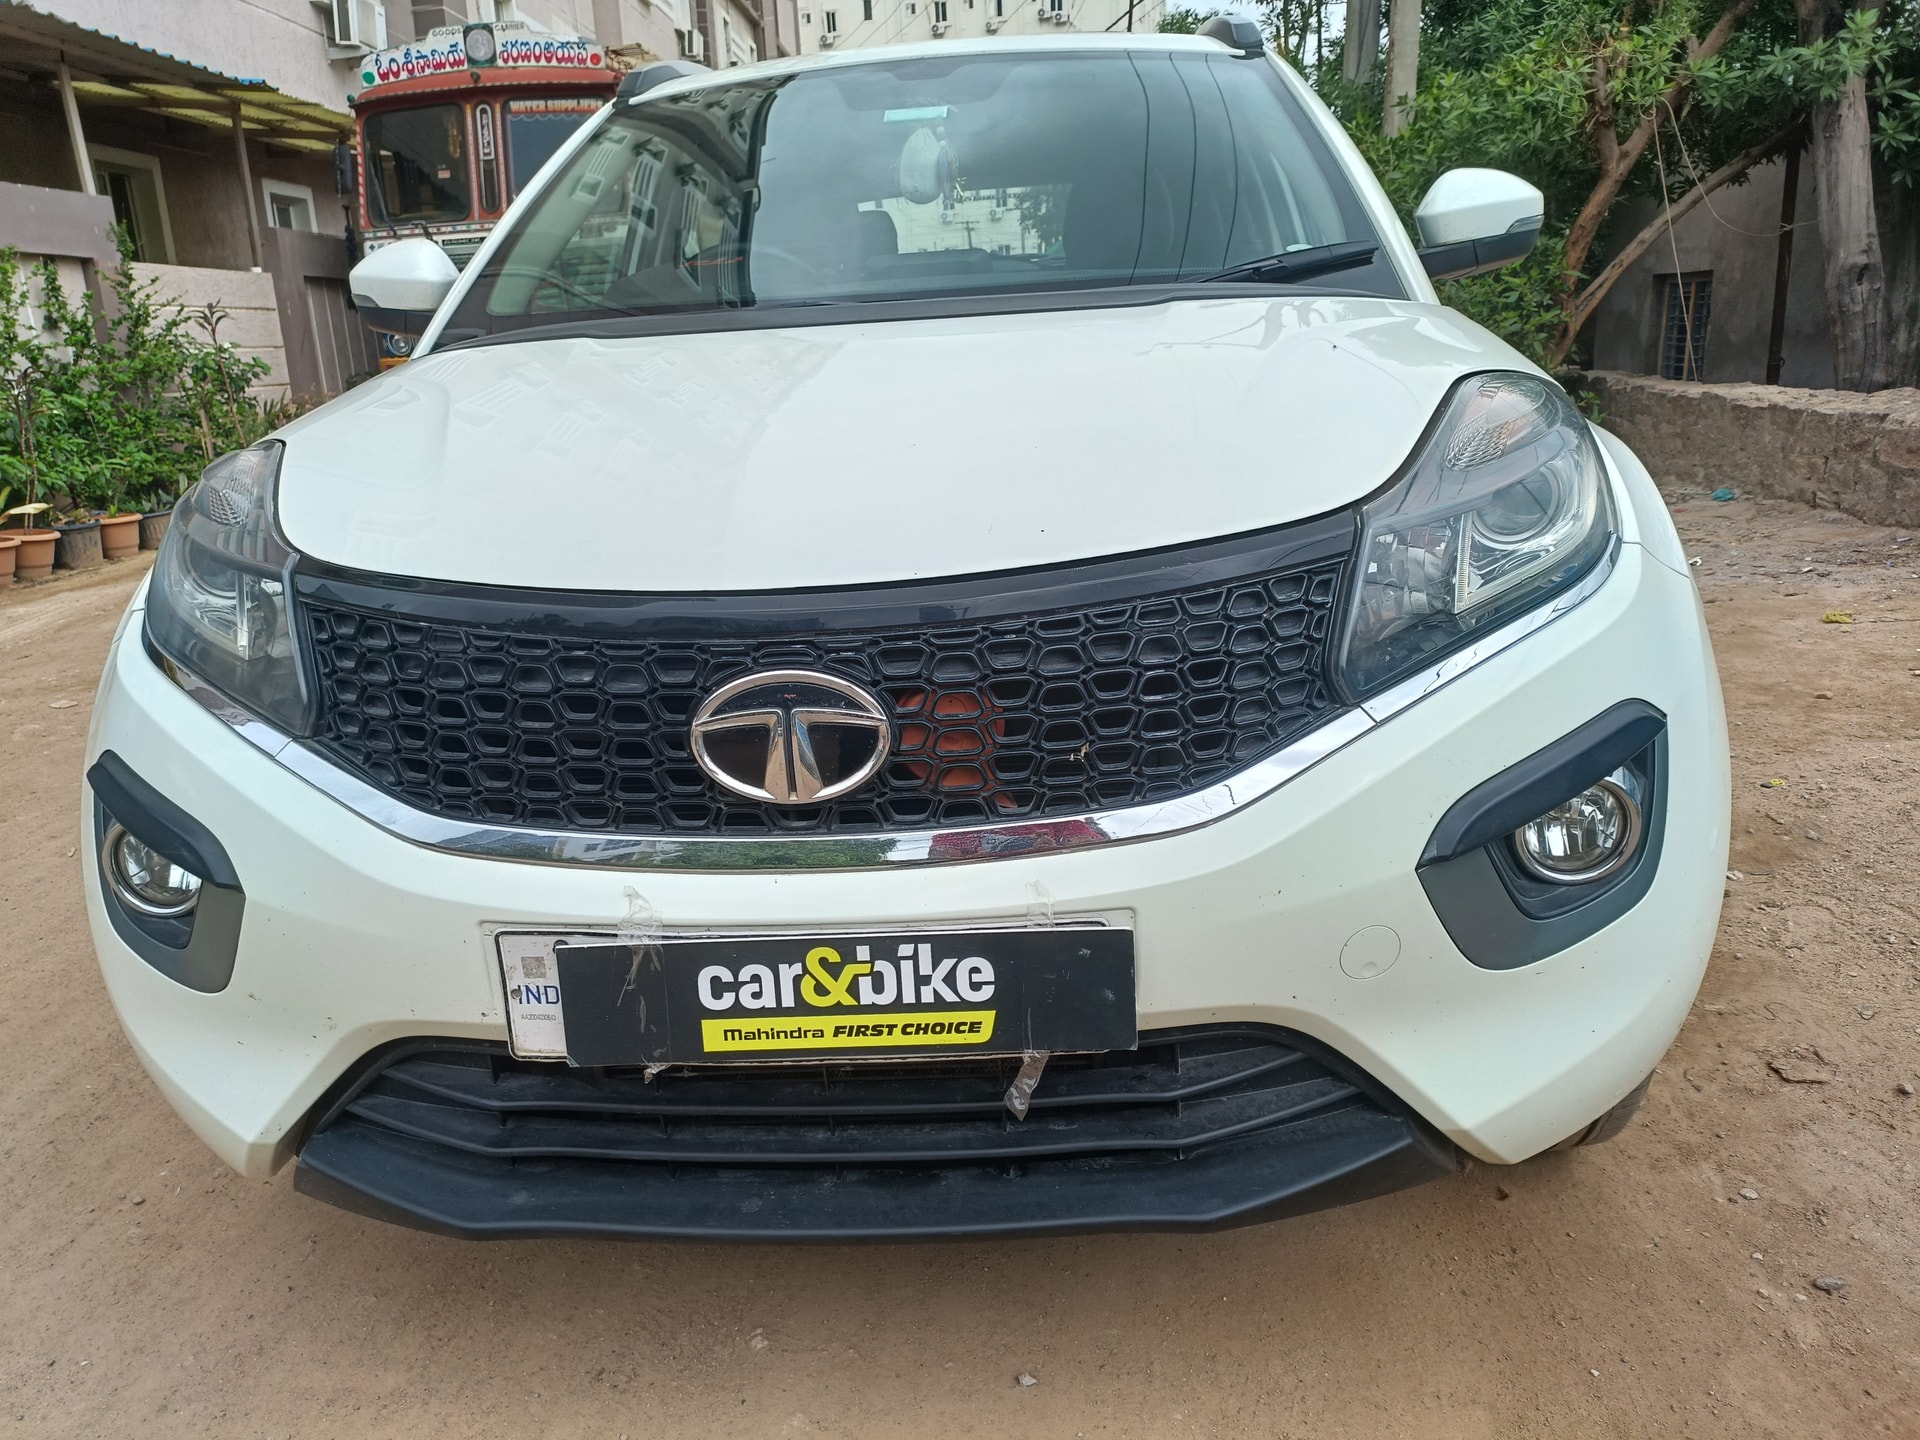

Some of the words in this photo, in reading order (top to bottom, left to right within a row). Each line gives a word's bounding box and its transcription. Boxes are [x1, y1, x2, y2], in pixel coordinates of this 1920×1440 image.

[509, 100, 546, 114] WATER
[518, 984, 561, 1005] IND
[723, 1026, 825, 1042] Mahindra
[832, 1023, 899, 1038] FIRST
[900, 1020, 983, 1036] CHOICE
